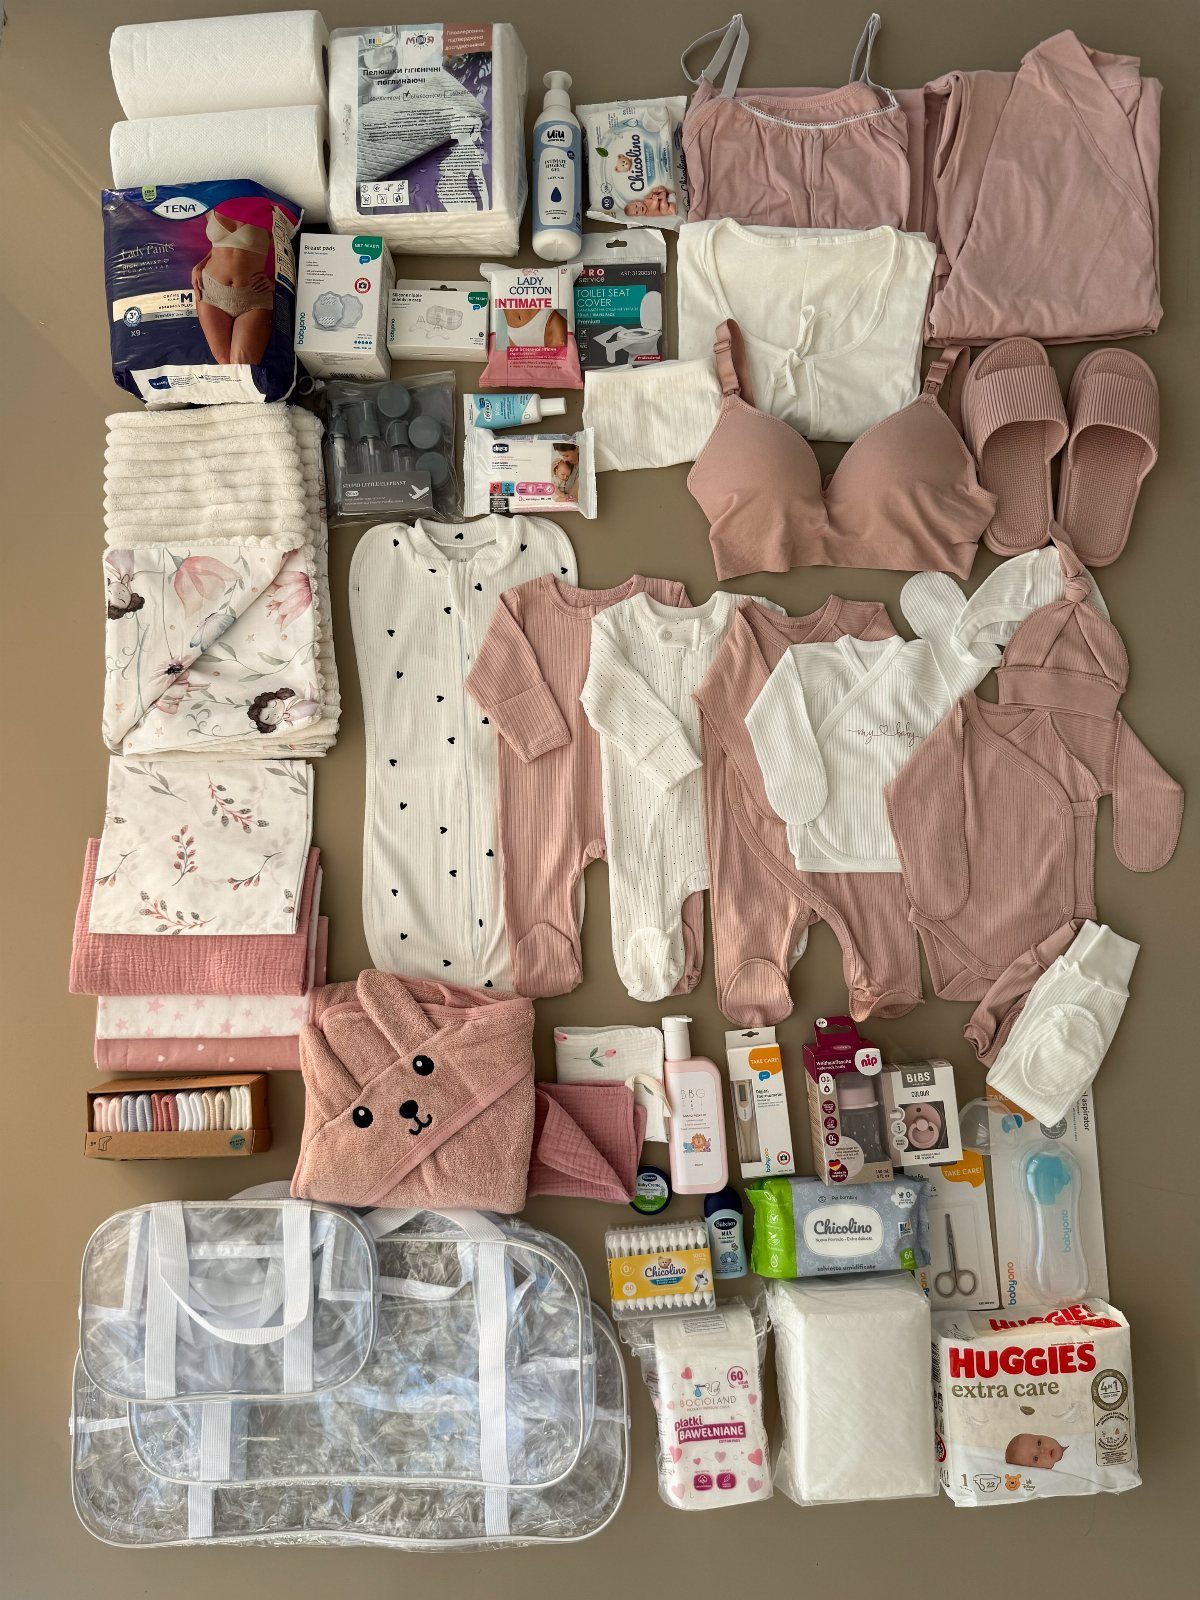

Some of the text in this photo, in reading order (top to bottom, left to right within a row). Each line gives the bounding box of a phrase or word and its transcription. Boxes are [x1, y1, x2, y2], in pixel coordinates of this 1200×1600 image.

[362, 67, 402, 76] Пелюшки
[378, 78, 426, 86] поглинаючі
[625, 134, 644, 192] Chicolino
[164, 204, 196, 214] TENA
[147, 244, 175, 255] Pants
[517, 276, 544, 286] LADY
[510, 286, 552, 294] COTTON
[576, 288, 630, 298] TOILET SEAT
[495, 298, 552, 308] INTIMATE
[576, 298, 612, 308] COVER
[297, 312, 306, 344] babyono
[861, 1054, 878, 1068] nip
[906, 1072, 930, 1083] BIBS
[1081, 1098, 1090, 1131] aspirator
[814, 1218, 872, 1235] Chicolino
[1062, 1209, 1071, 1253] babyono
[645, 1264, 686, 1278] Chicolino
[1008, 1261, 1018, 1306] babyono
[949, 1343, 1096, 1379] HUGGIES
[730, 1370, 744, 1382] 60
[952, 1380, 1060, 1398] extra care
[680, 1396, 736, 1408] BOCIOLAND
[674, 1416, 703, 1431] płatki
[679, 1426, 744, 1441] BAWEŁNIANE
[961, 1474, 968, 1487] 1
